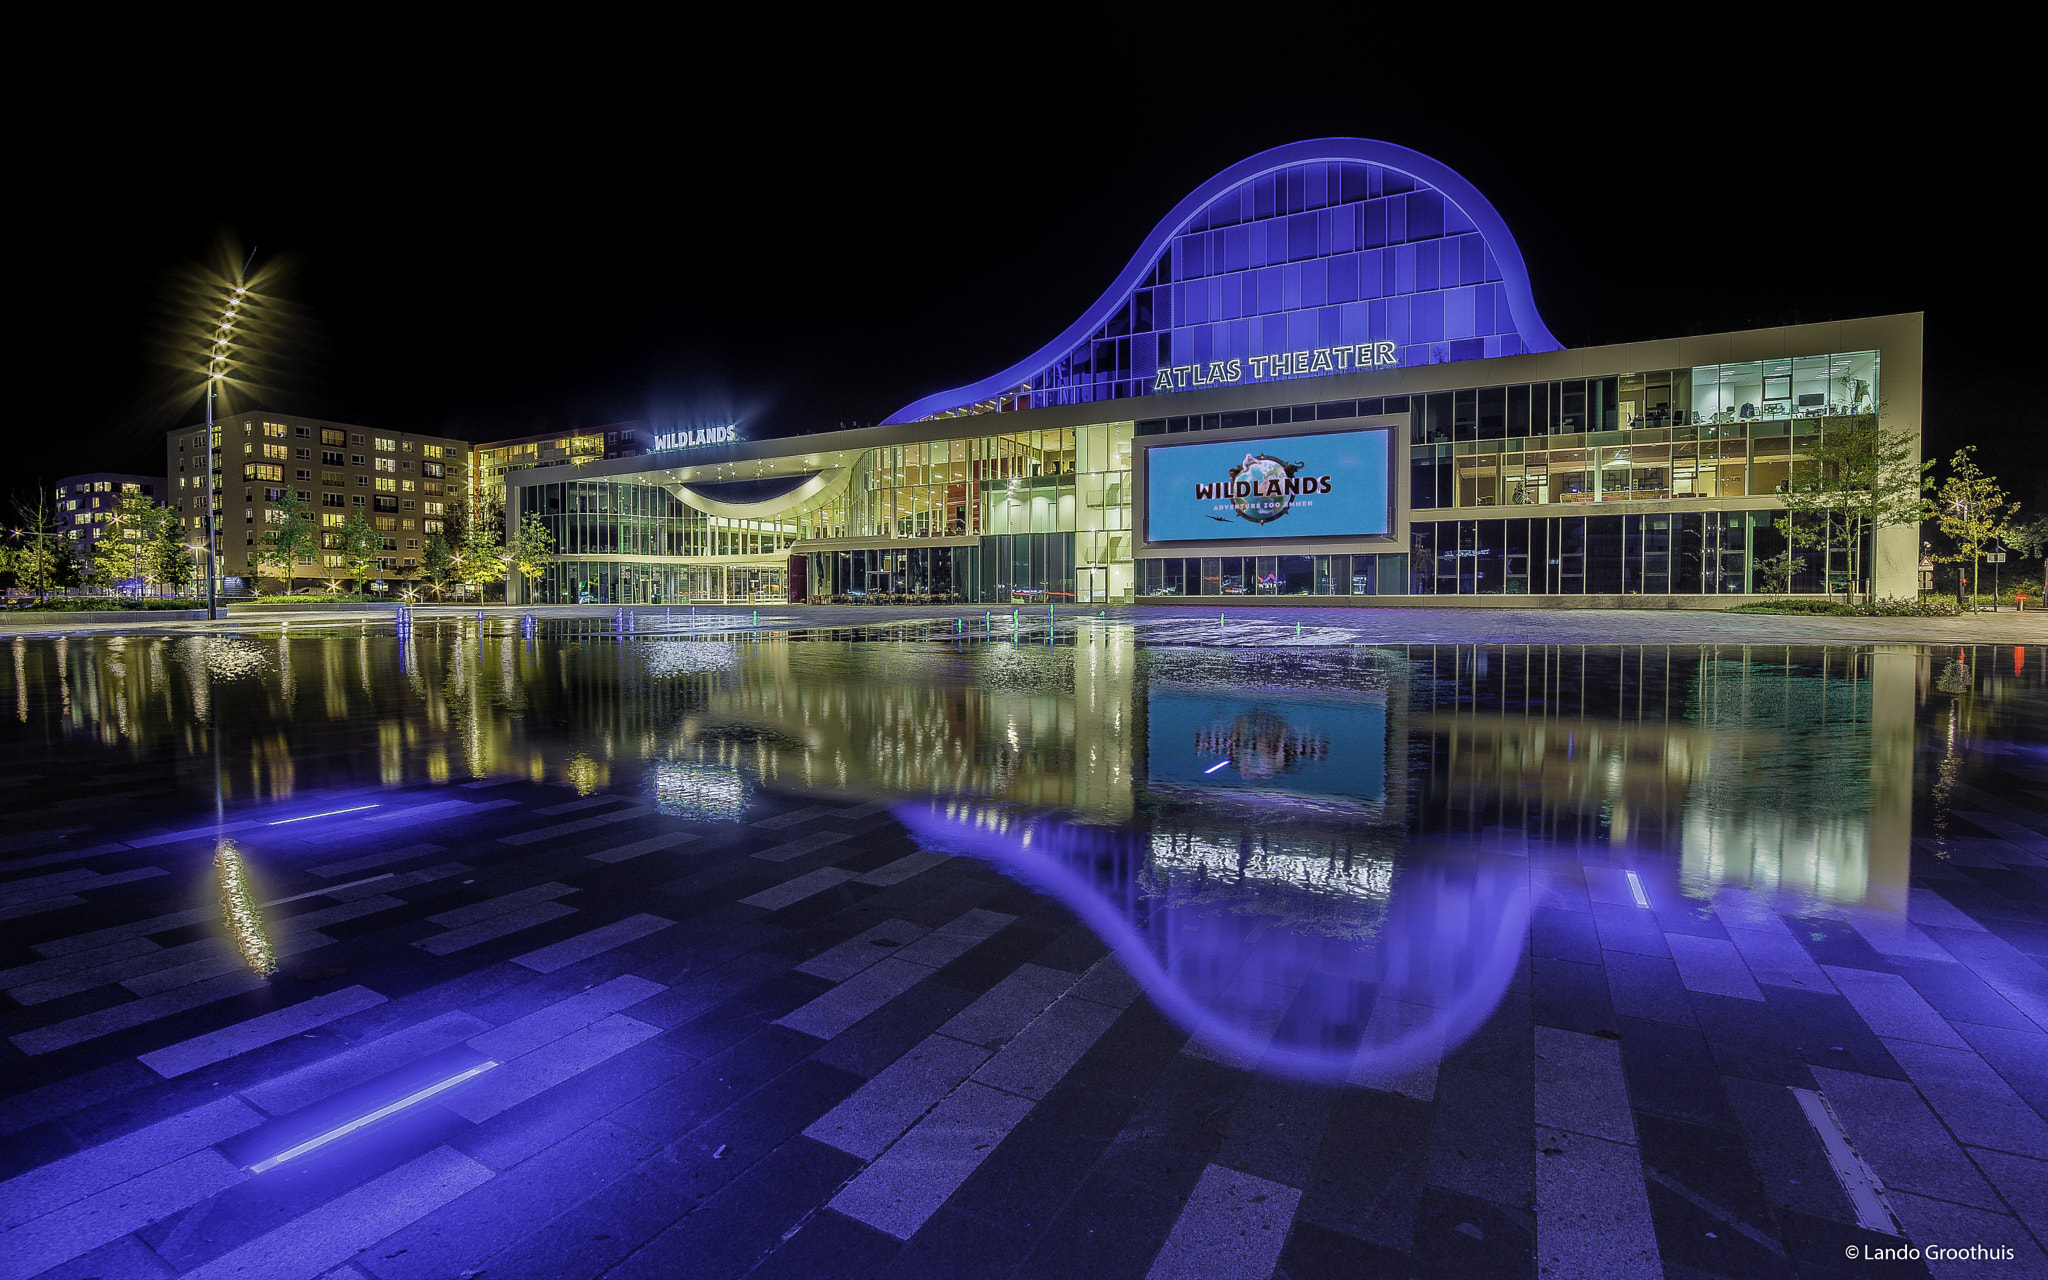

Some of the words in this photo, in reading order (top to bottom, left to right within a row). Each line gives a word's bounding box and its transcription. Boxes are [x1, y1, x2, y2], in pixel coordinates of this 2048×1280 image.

[1154, 359, 1242, 390] ATLAS
[1248, 341, 1398, 378] THEATER
[654, 425, 735, 451] WILDLANDS
[1195, 475, 1332, 500] WILDLANDS
[1213, 503, 1260, 511] ADVENTURE
[1263, 501, 1281, 509] ZOO
[1284, 500, 1313, 508] EMMEN
